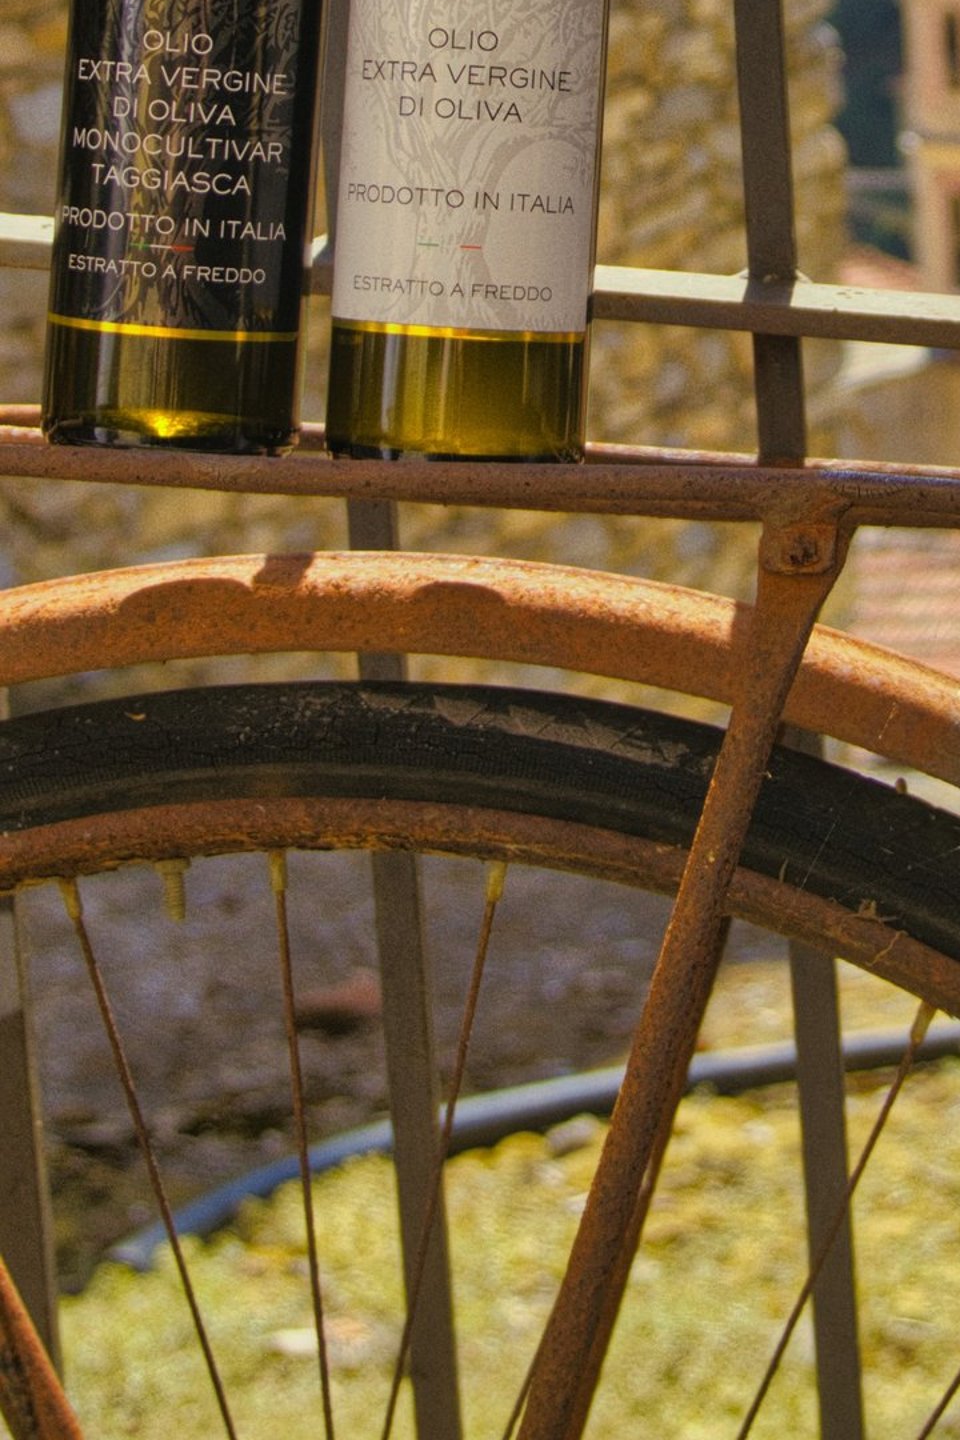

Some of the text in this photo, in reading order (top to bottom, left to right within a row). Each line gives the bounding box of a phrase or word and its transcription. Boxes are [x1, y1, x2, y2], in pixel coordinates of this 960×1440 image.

[143, 29, 214, 55] OLIO
[428, 27, 499, 52] OLIO
[78, 58, 288, 95] EXTRA VERGINE
[362, 60, 572, 92] EXTRA VERGINE
[113, 96, 236, 127] DI OLIVA
[399, 96, 523, 123] DI OLIVA
[73, 127, 283, 163] MONOCULTIVAR
[91, 163, 251, 196] TAGGIASCA
[348, 183, 575, 215] PRODOTTO IN ITALIA
[62, 205, 287, 241] PRODOTTO IN ITALIA
[68, 254, 266, 285] ESTRATTO A FREDDO
[353, 275, 553, 302] ESTRATTO A FREDDO
